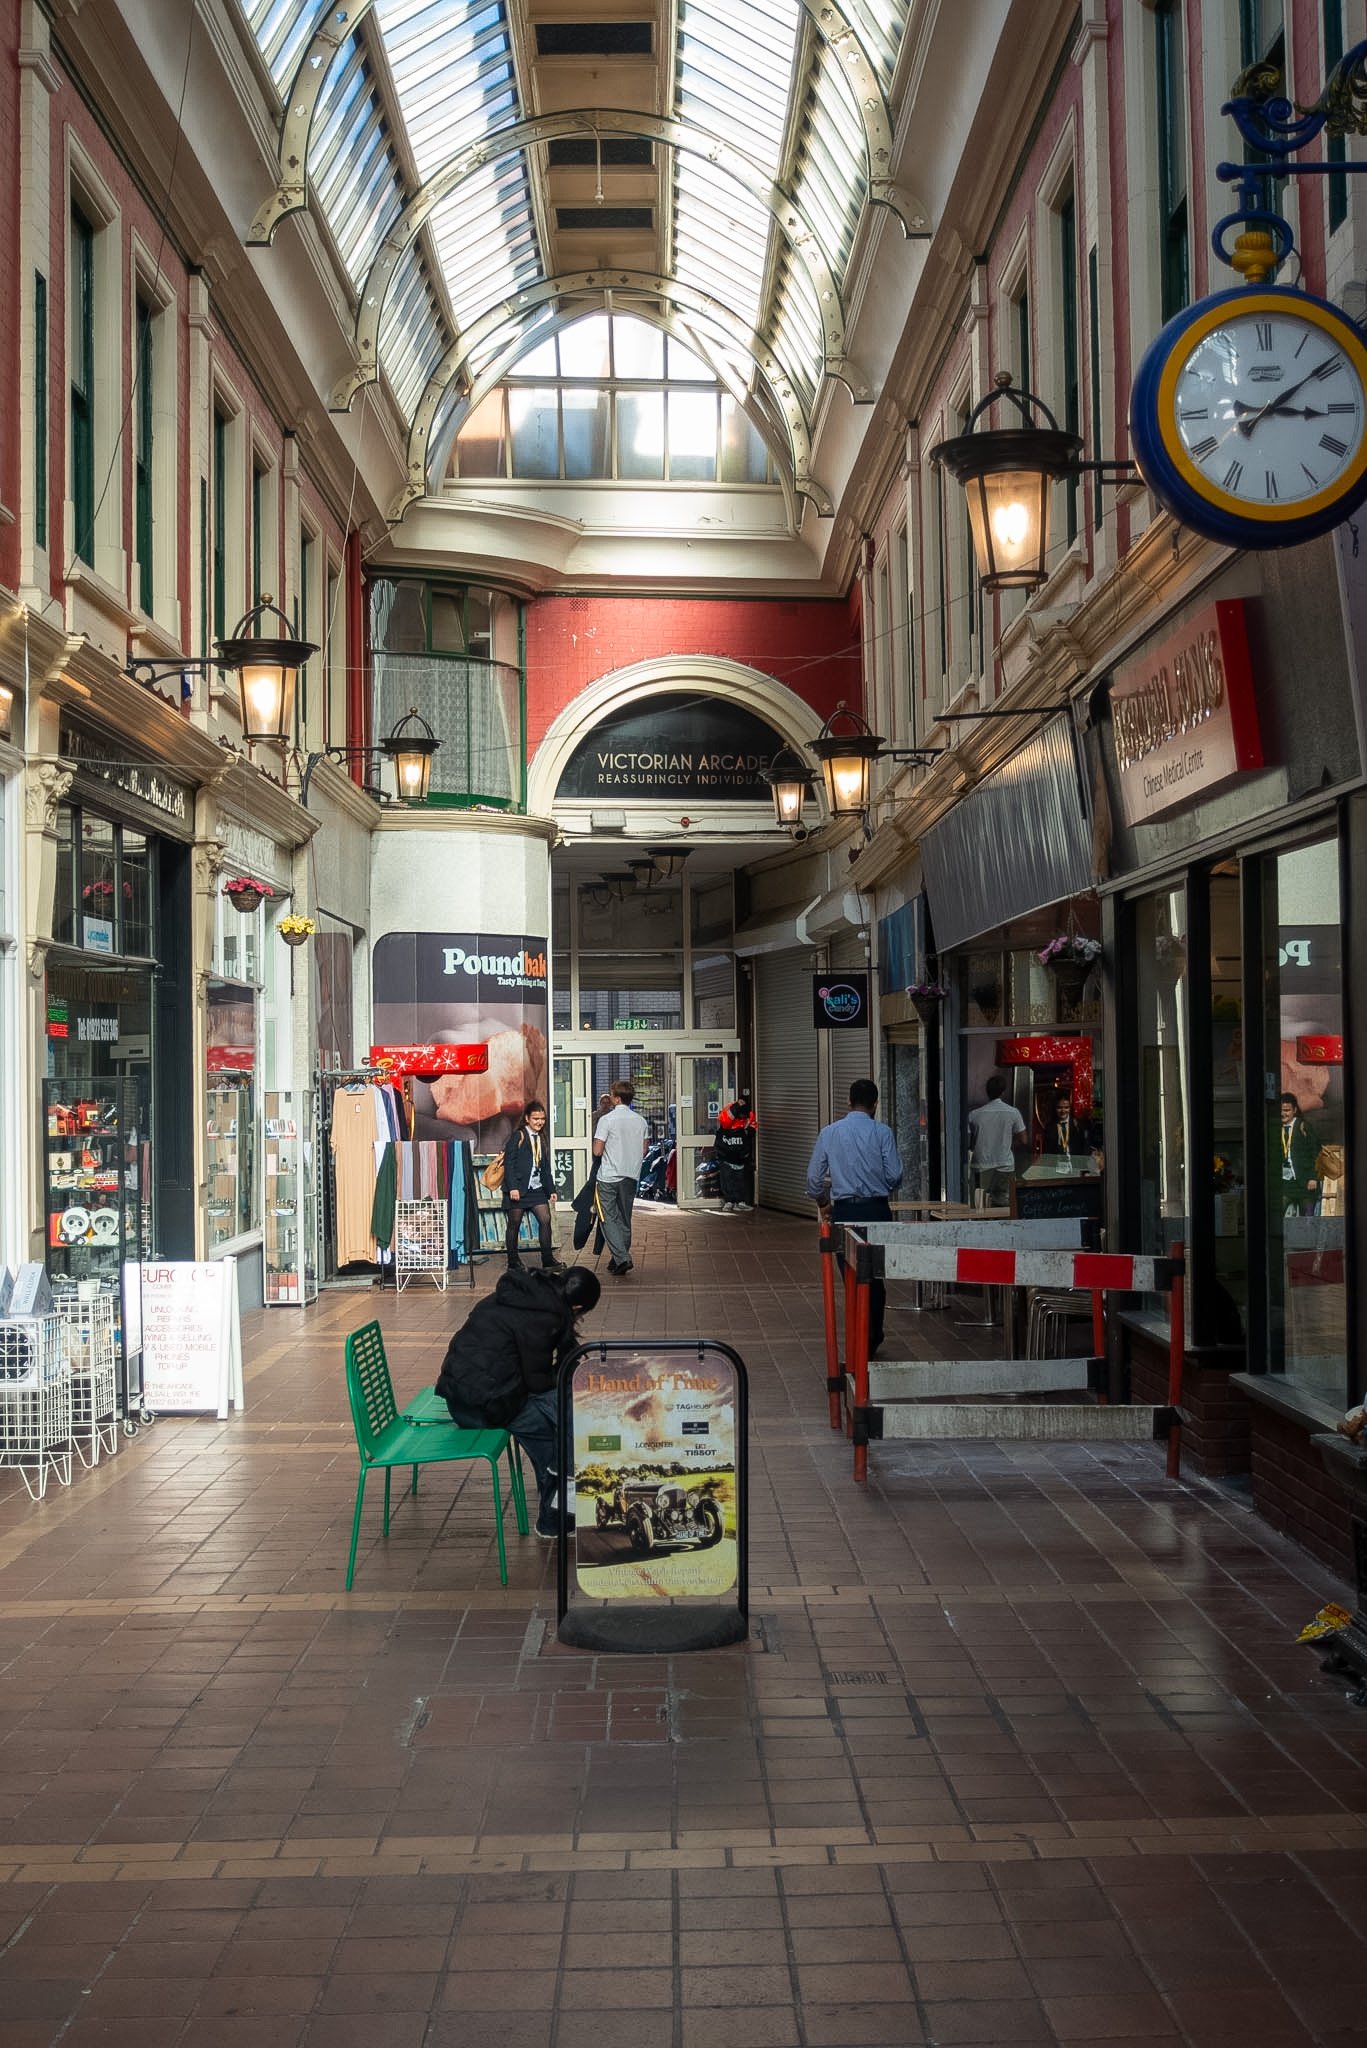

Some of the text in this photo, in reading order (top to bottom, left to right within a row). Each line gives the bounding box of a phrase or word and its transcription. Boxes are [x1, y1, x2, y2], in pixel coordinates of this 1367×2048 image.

[597, 753, 769, 771] VICTORIAN ARCADE
[598, 773, 691, 784] REASSURINGLY
[1143, 749, 1205, 799] Chinese Medical Centre
[587, 1373, 718, 1393] Hand of Time
[635, 1441, 673, 1449] LONGINES
[685, 1449, 718, 1457] TISSOT
